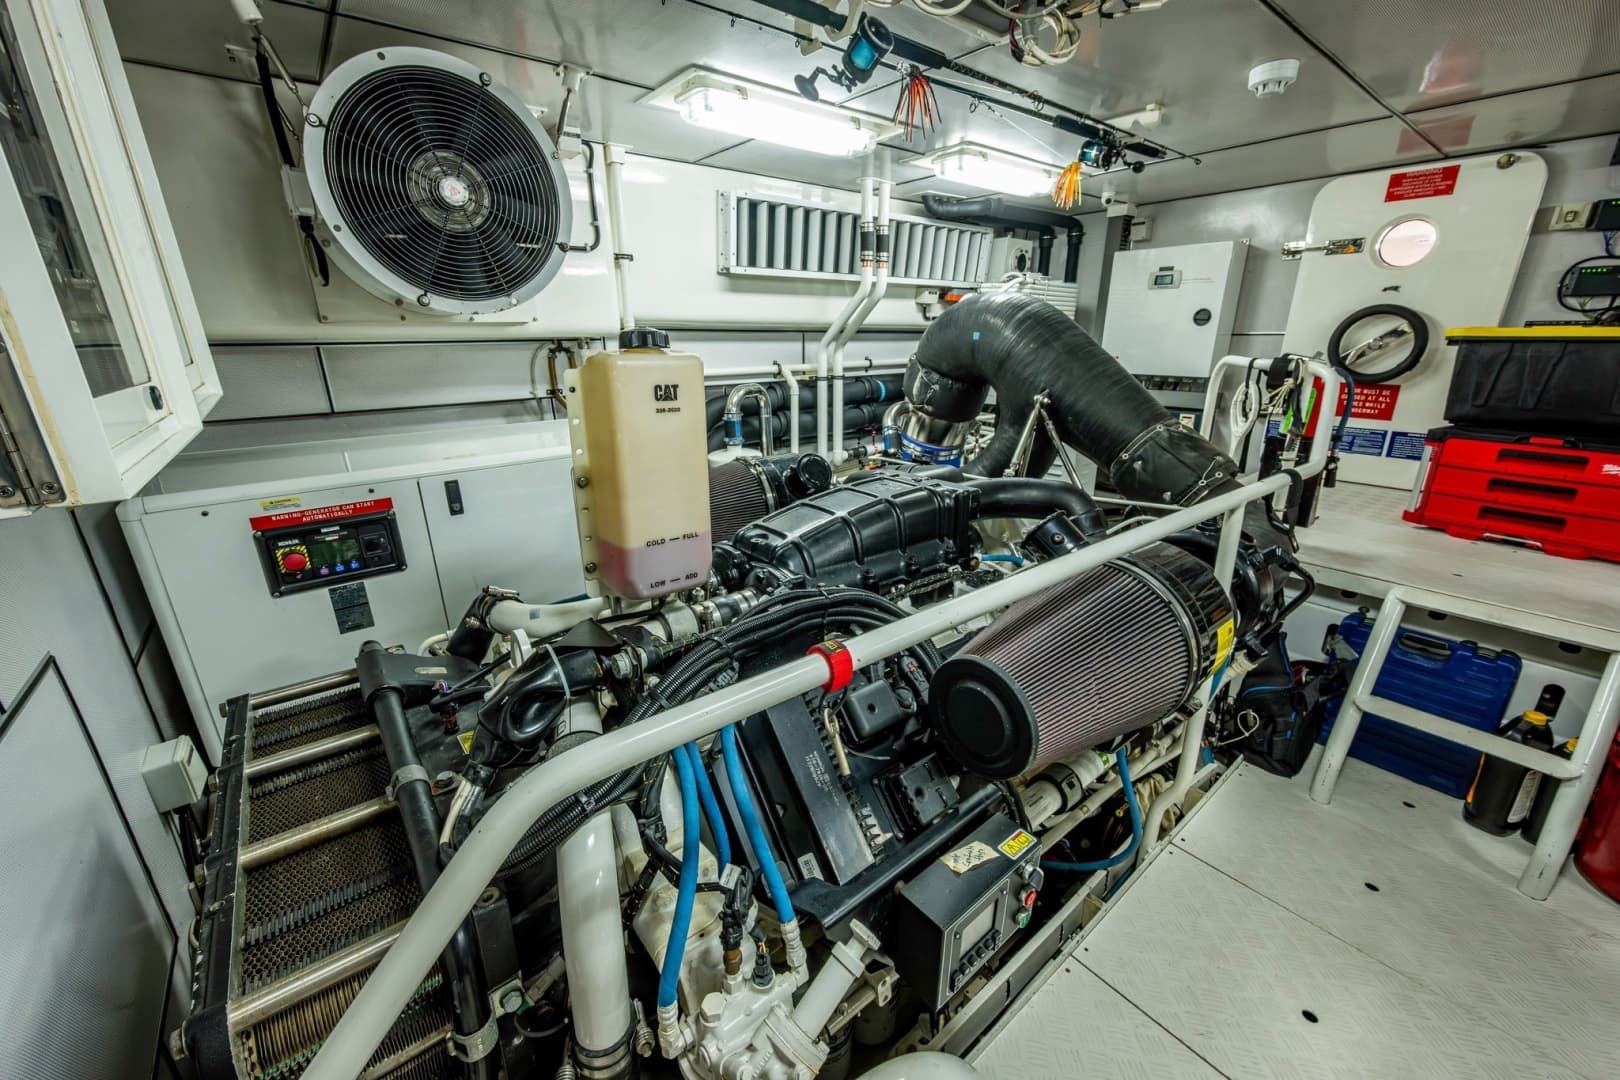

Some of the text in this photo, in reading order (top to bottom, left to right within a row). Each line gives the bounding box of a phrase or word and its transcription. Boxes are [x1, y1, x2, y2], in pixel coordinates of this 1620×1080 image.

[654, 384, 679, 402] CAT
[356, 501, 375, 509] START
[302, 509, 353, 522] AUTOMATICALLY
[646, 531, 699, 547] COLD FULL
[650, 572, 698, 589] LOW ADD
